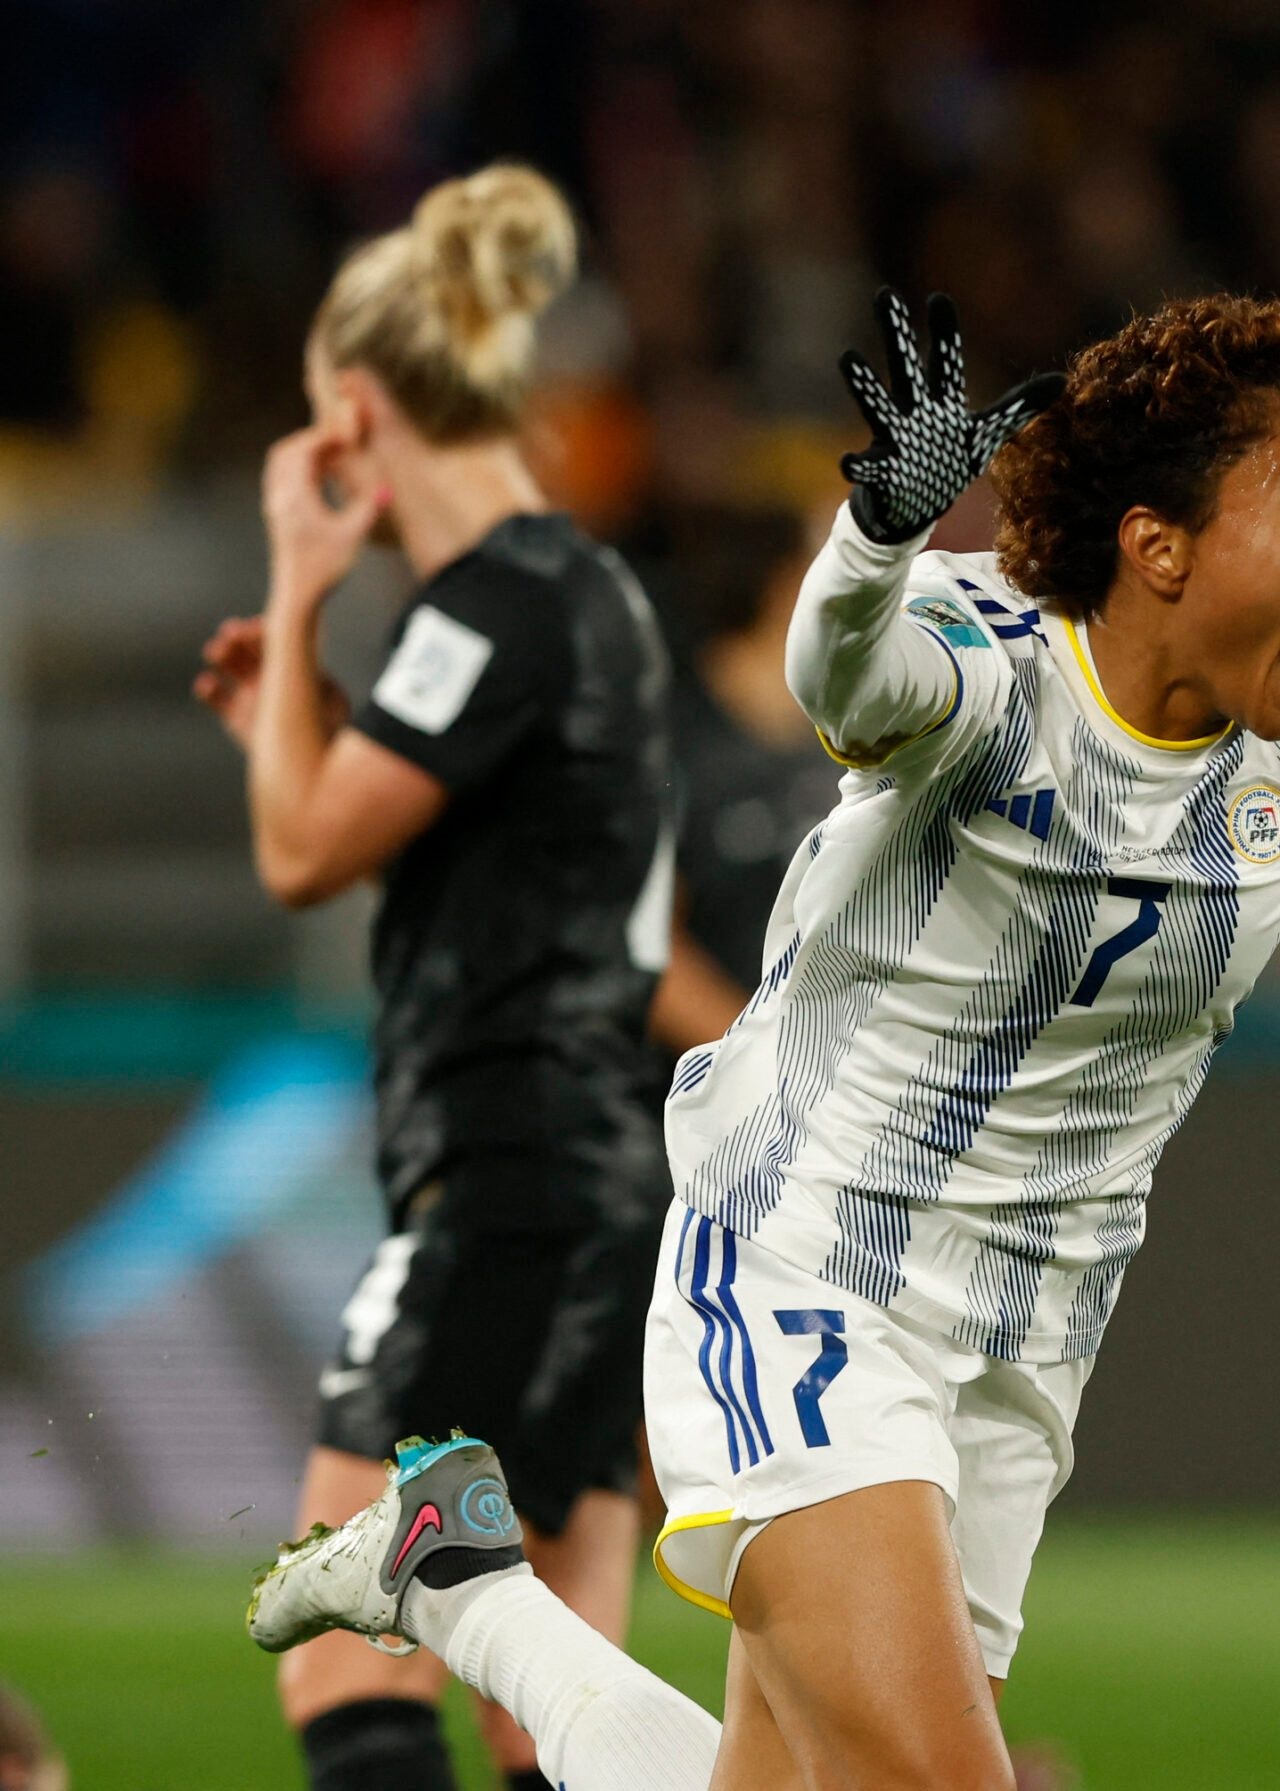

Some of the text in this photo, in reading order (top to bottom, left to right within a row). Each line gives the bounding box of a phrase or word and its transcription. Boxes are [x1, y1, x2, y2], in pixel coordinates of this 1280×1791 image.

[1240, 791, 1274, 806] FOOTBALL
[1233, 806, 1250, 853] PHILIPPINE
[1249, 827, 1279, 843] PFF
[1069, 877, 1173, 1008] 7
[772, 1309, 848, 1448] 7
